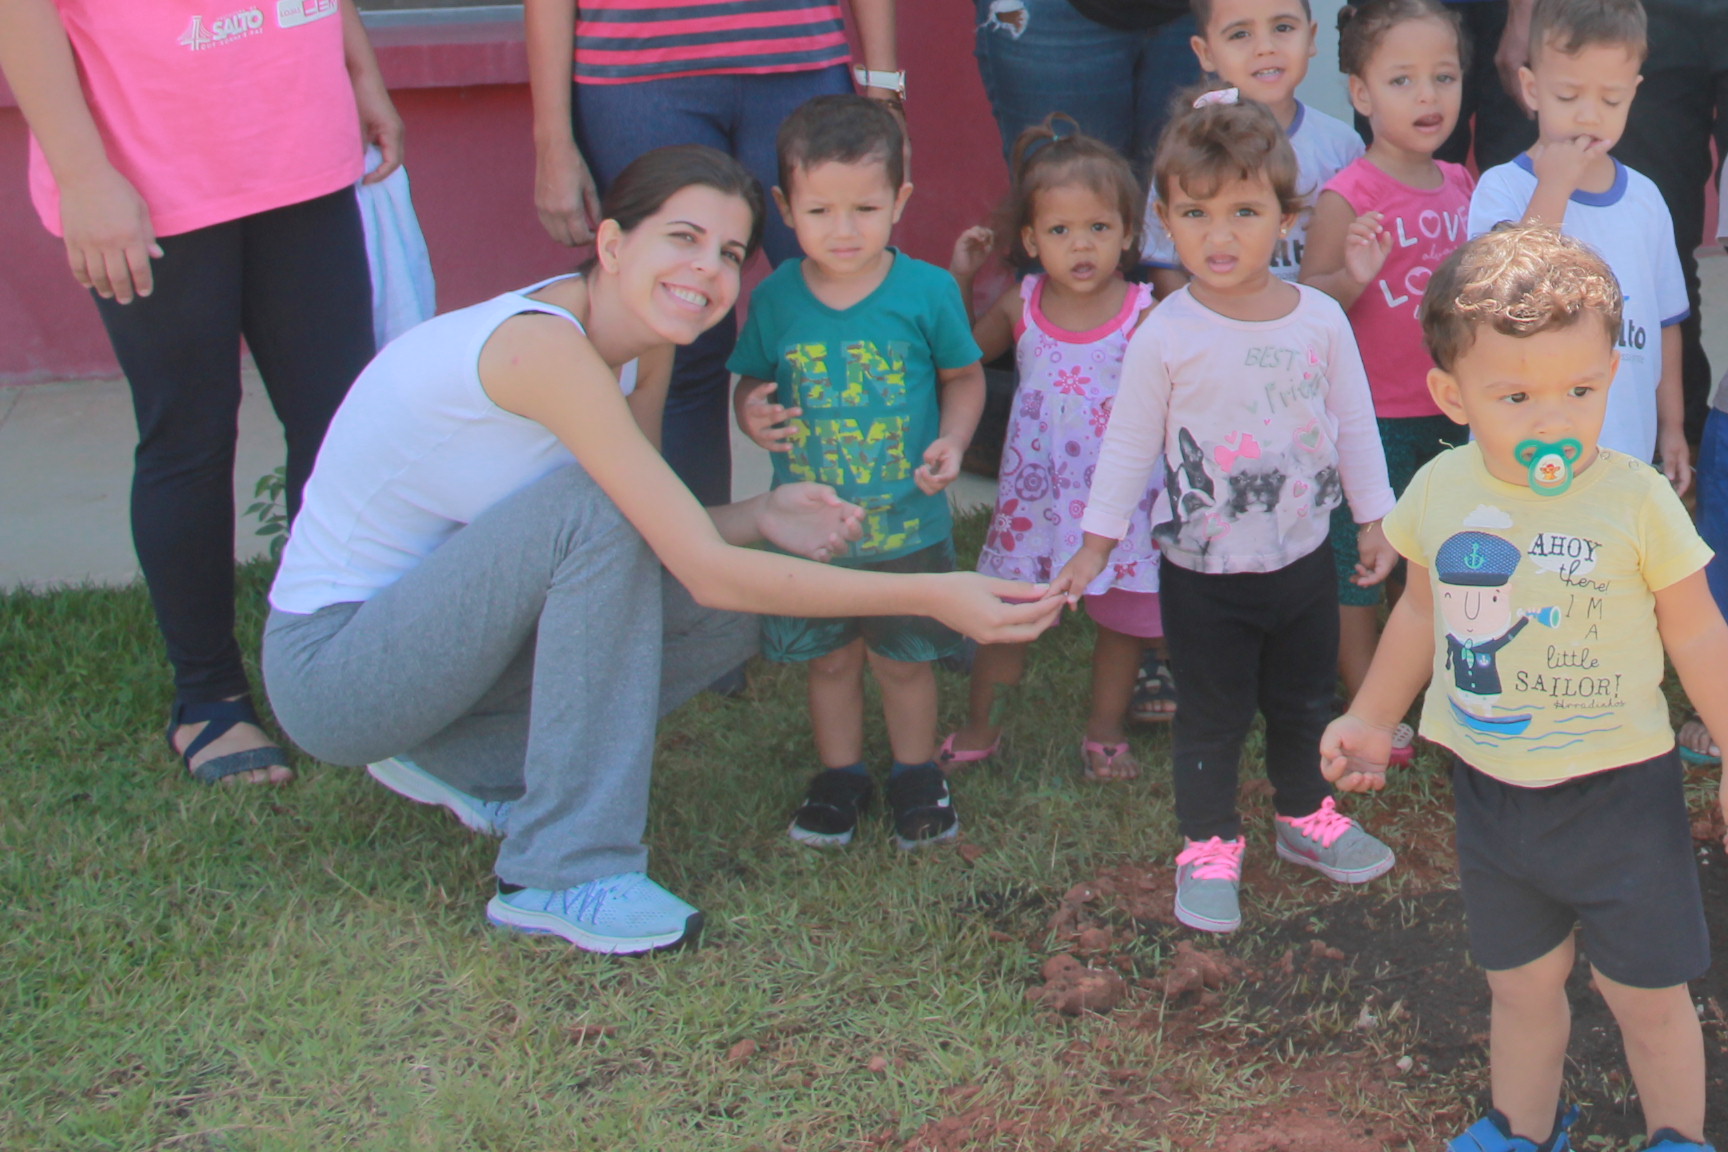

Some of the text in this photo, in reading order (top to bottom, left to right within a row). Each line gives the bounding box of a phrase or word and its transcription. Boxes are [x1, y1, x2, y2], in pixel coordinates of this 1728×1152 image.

[212, 9, 264, 40] SALTO
[1379, 266, 1433, 308] LO
[1244, 346, 1300, 371] BEST
[1527, 533, 1602, 562] AHOY
[1584, 623, 1599, 641] A
[1547, 644, 1600, 670] little
[1515, 670, 1622, 699] SAILOR!
